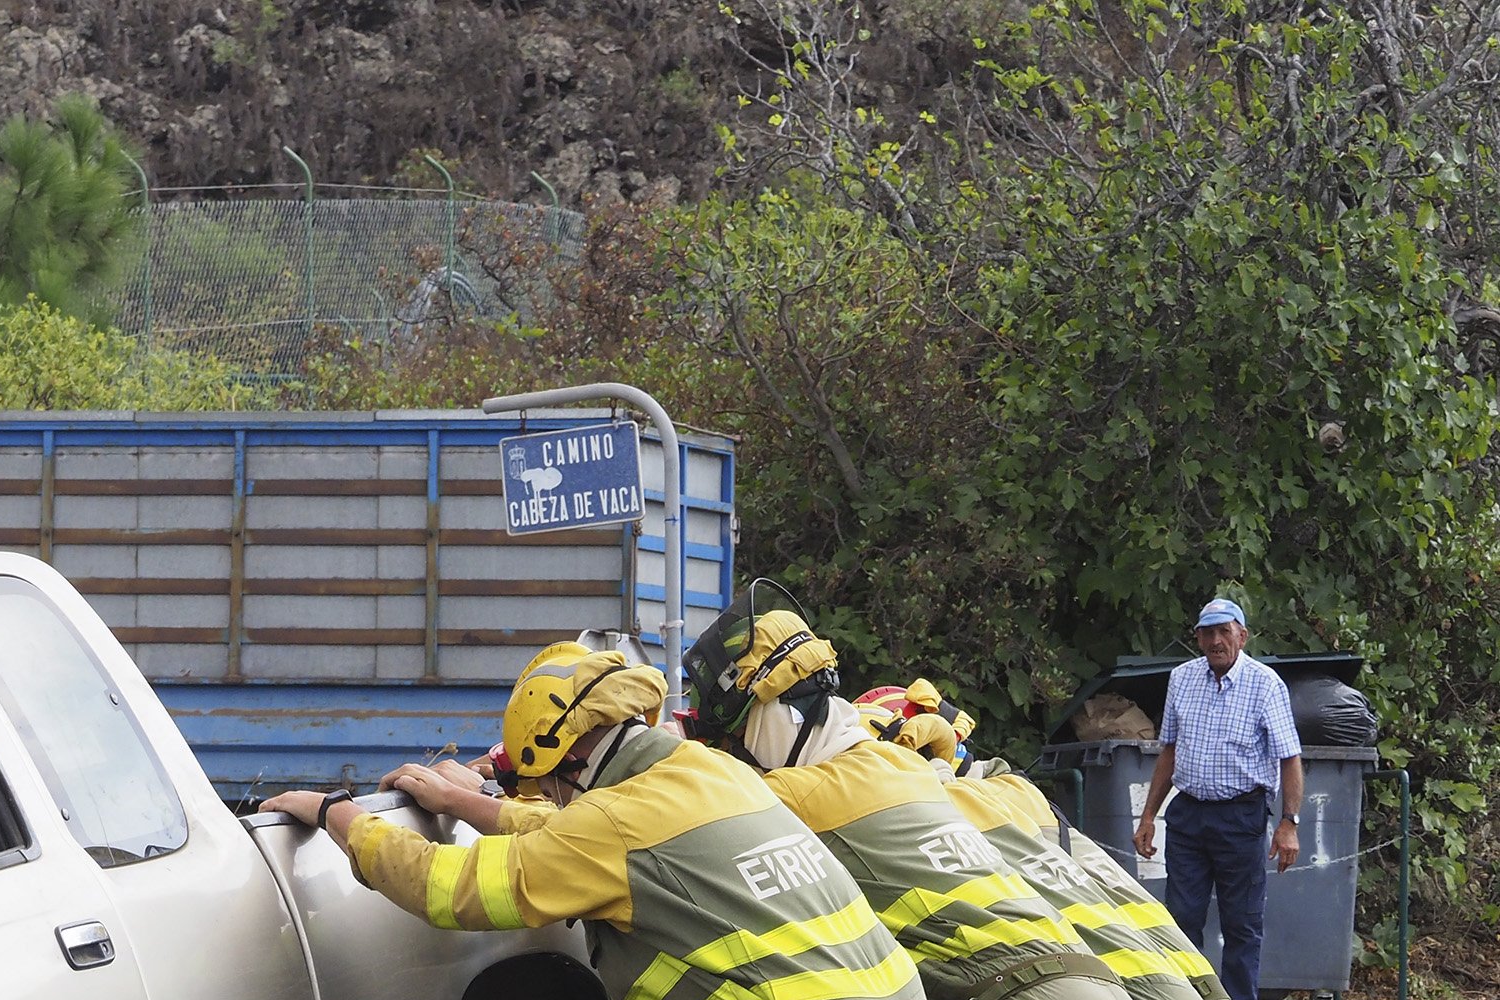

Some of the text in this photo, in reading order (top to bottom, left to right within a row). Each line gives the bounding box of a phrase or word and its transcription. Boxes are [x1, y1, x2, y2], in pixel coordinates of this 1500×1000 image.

[542, 433, 614, 467] CAMINO
[509, 486, 640, 527] CABEZA DE VACA
